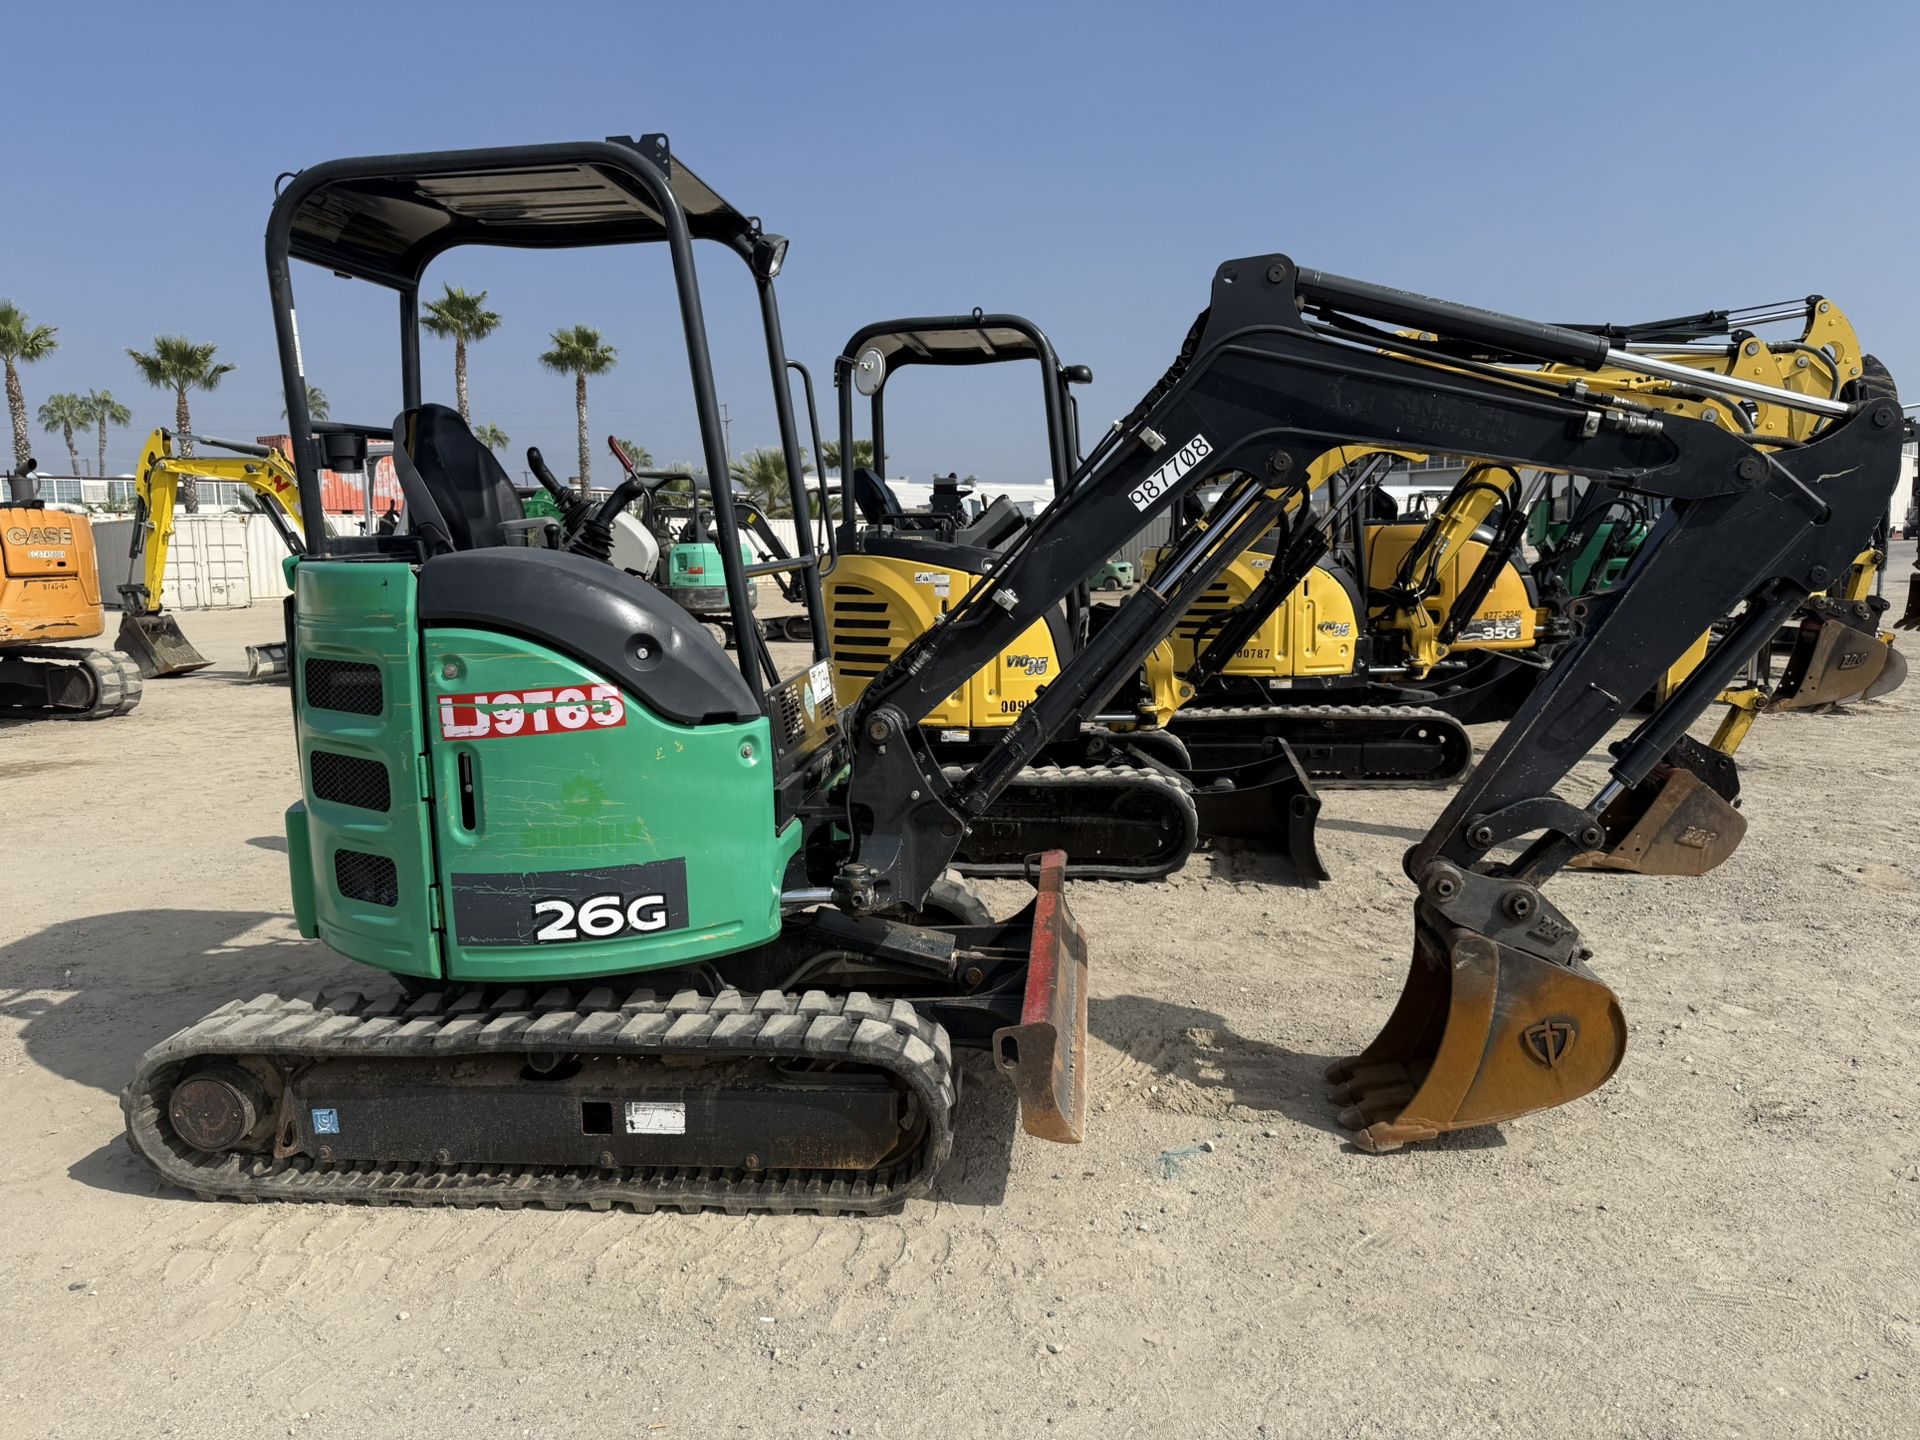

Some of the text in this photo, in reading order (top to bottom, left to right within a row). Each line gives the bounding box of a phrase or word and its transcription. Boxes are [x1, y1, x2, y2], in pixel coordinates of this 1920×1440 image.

[6, 527, 72, 546] CASE
[1482, 626, 1518, 640] 35G
[534, 894, 667, 942] 26G
